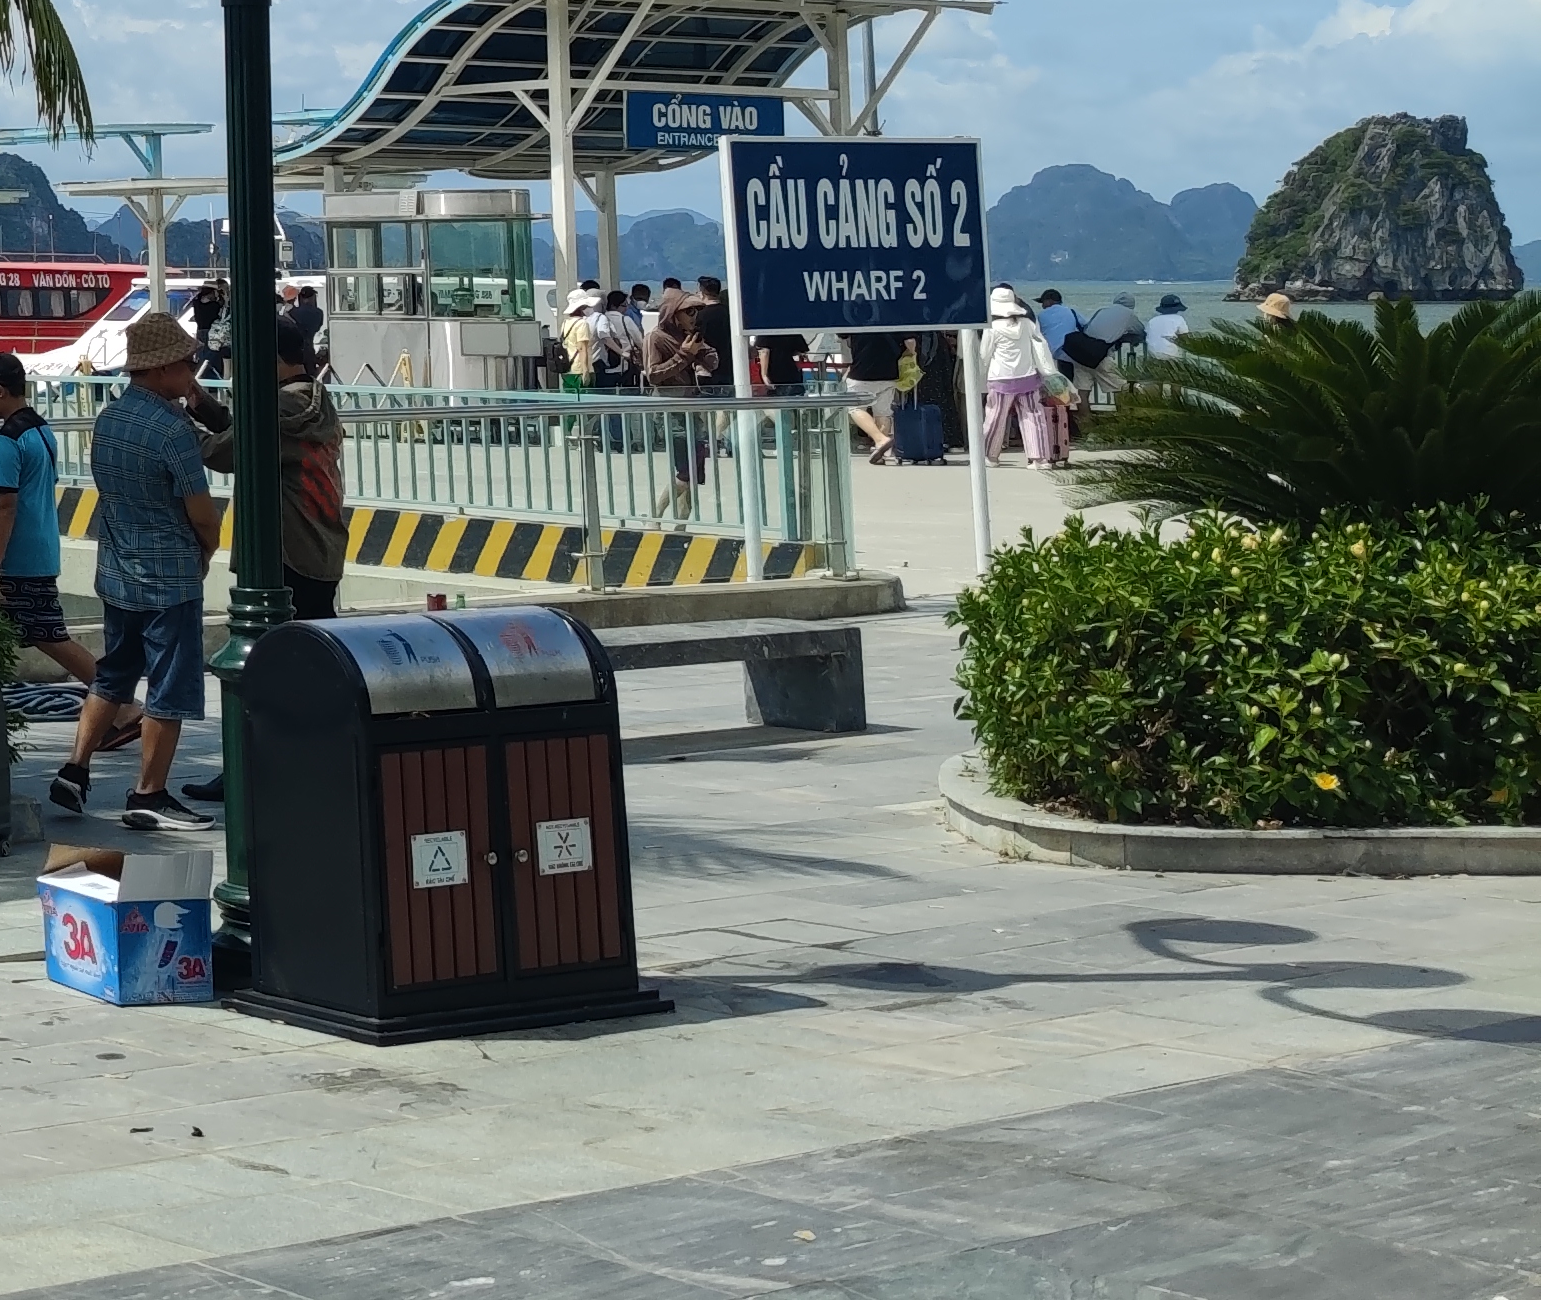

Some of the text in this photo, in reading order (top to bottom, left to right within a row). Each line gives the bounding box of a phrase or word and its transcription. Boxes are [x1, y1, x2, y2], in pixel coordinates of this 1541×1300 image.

[652, 94, 758, 130] CỔNG VÀO
[657, 131, 718, 147] ENTRANCE
[746, 154, 971, 249] CẦU CẢNG SỐ 2
[8, 273, 20, 286] 28
[803, 270, 927, 301] WHARF 2
[420, 655, 441, 664] PUSH
[62, 913, 97, 965] 3A
[178, 957, 205, 979] 3A
